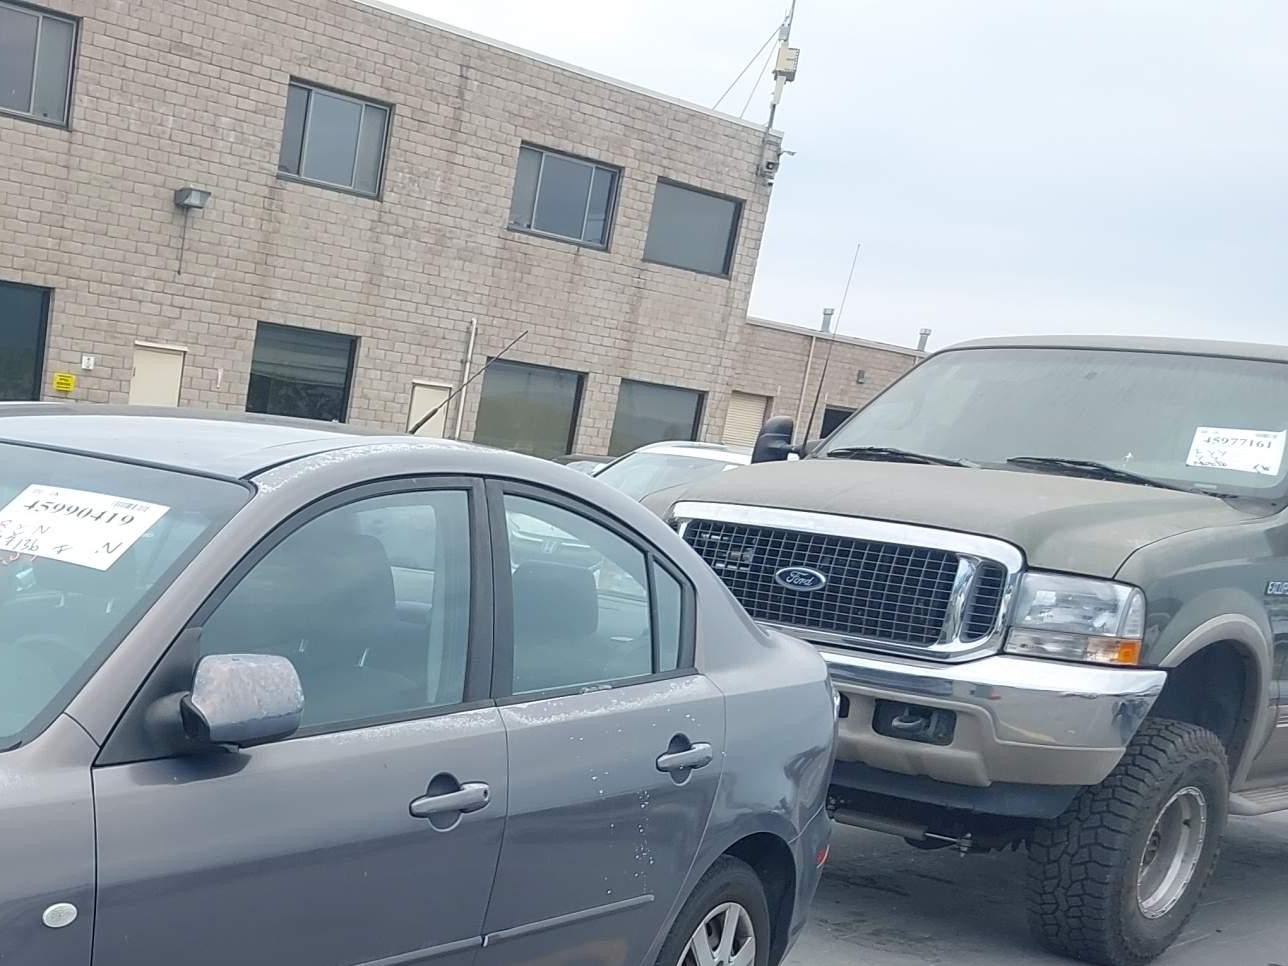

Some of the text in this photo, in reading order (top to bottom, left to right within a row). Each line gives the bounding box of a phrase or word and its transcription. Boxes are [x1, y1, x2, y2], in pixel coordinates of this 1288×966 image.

[1203, 437, 1272, 449] 45977161
[24, 499, 135, 526] 45990419
[785, 571, 815, 586] Ford
